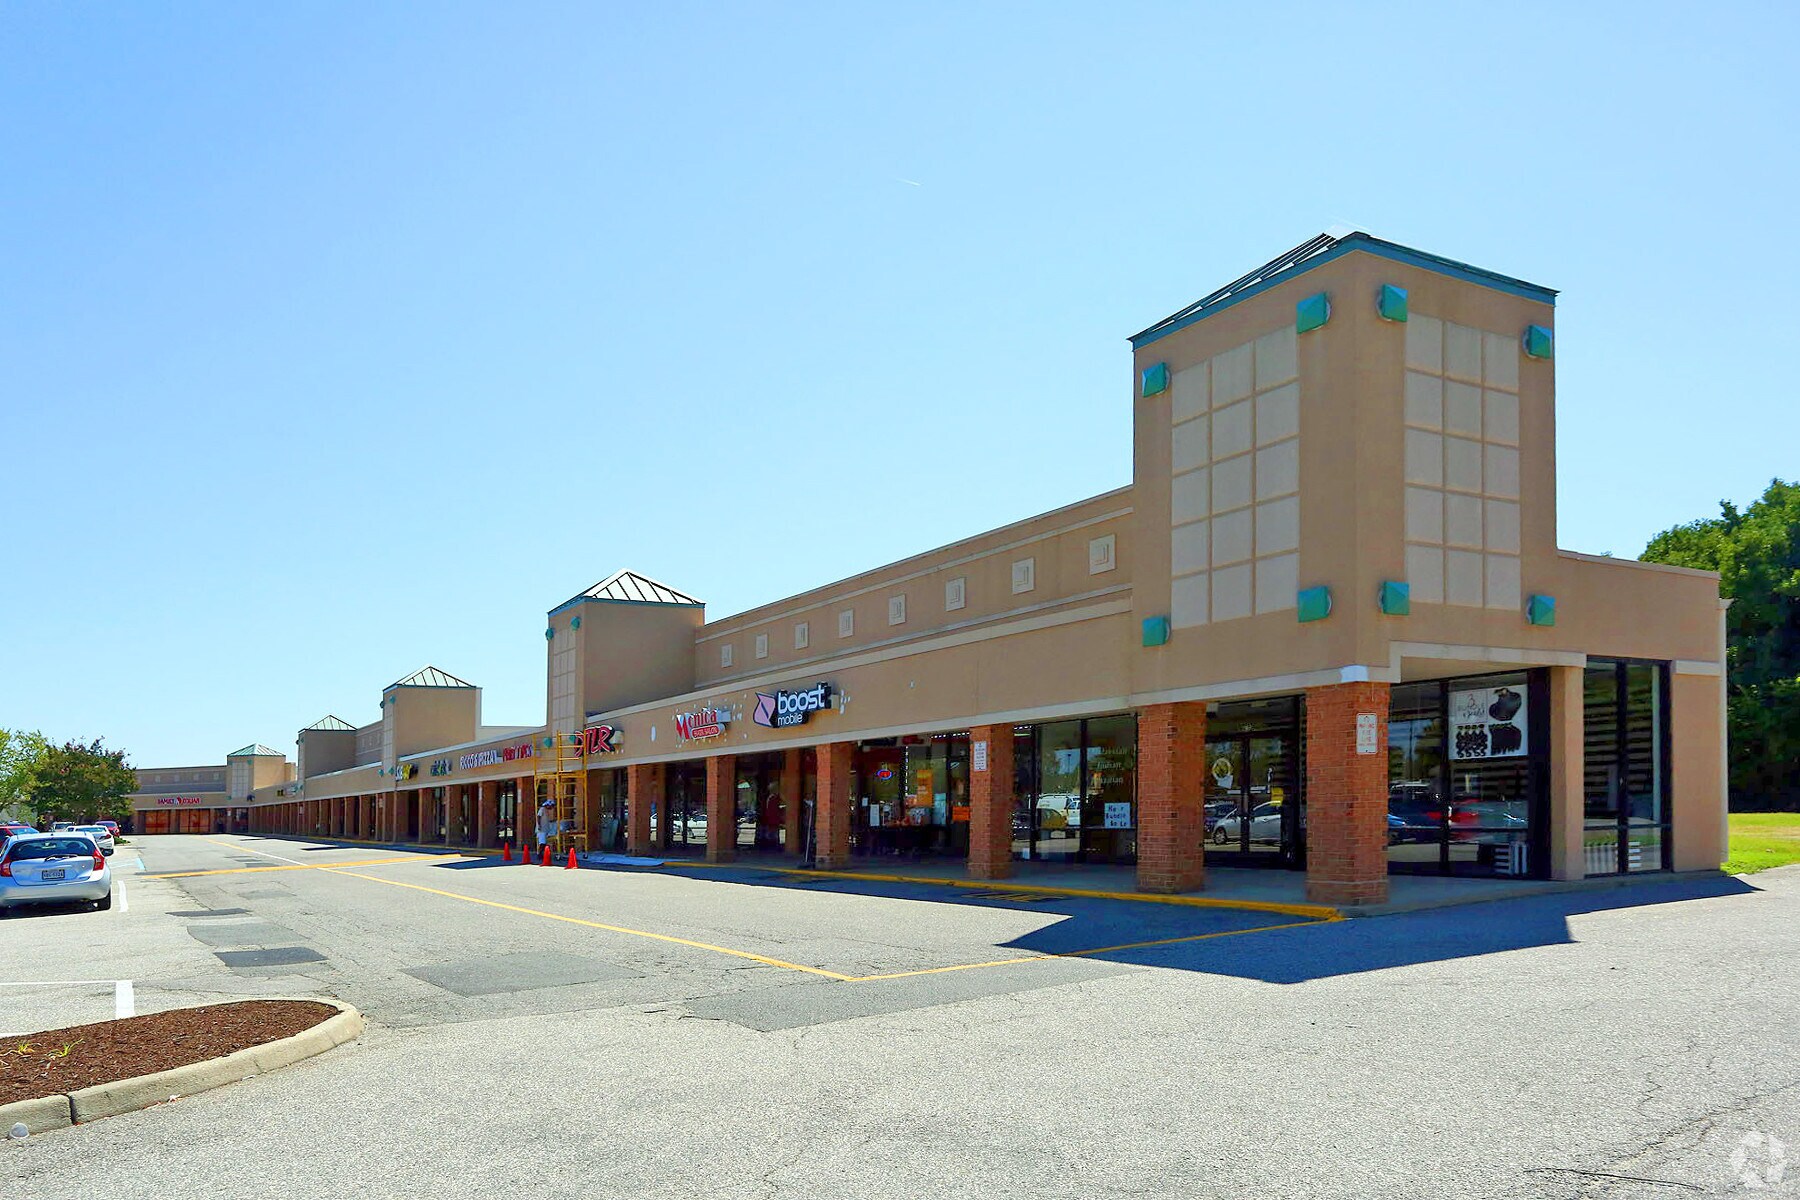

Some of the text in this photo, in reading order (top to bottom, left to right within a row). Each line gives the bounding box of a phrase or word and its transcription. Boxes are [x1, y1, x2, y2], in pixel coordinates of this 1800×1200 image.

[778, 685, 824, 713] boost
[676, 709, 717, 739] Monica
[778, 713, 803, 726] mobile
